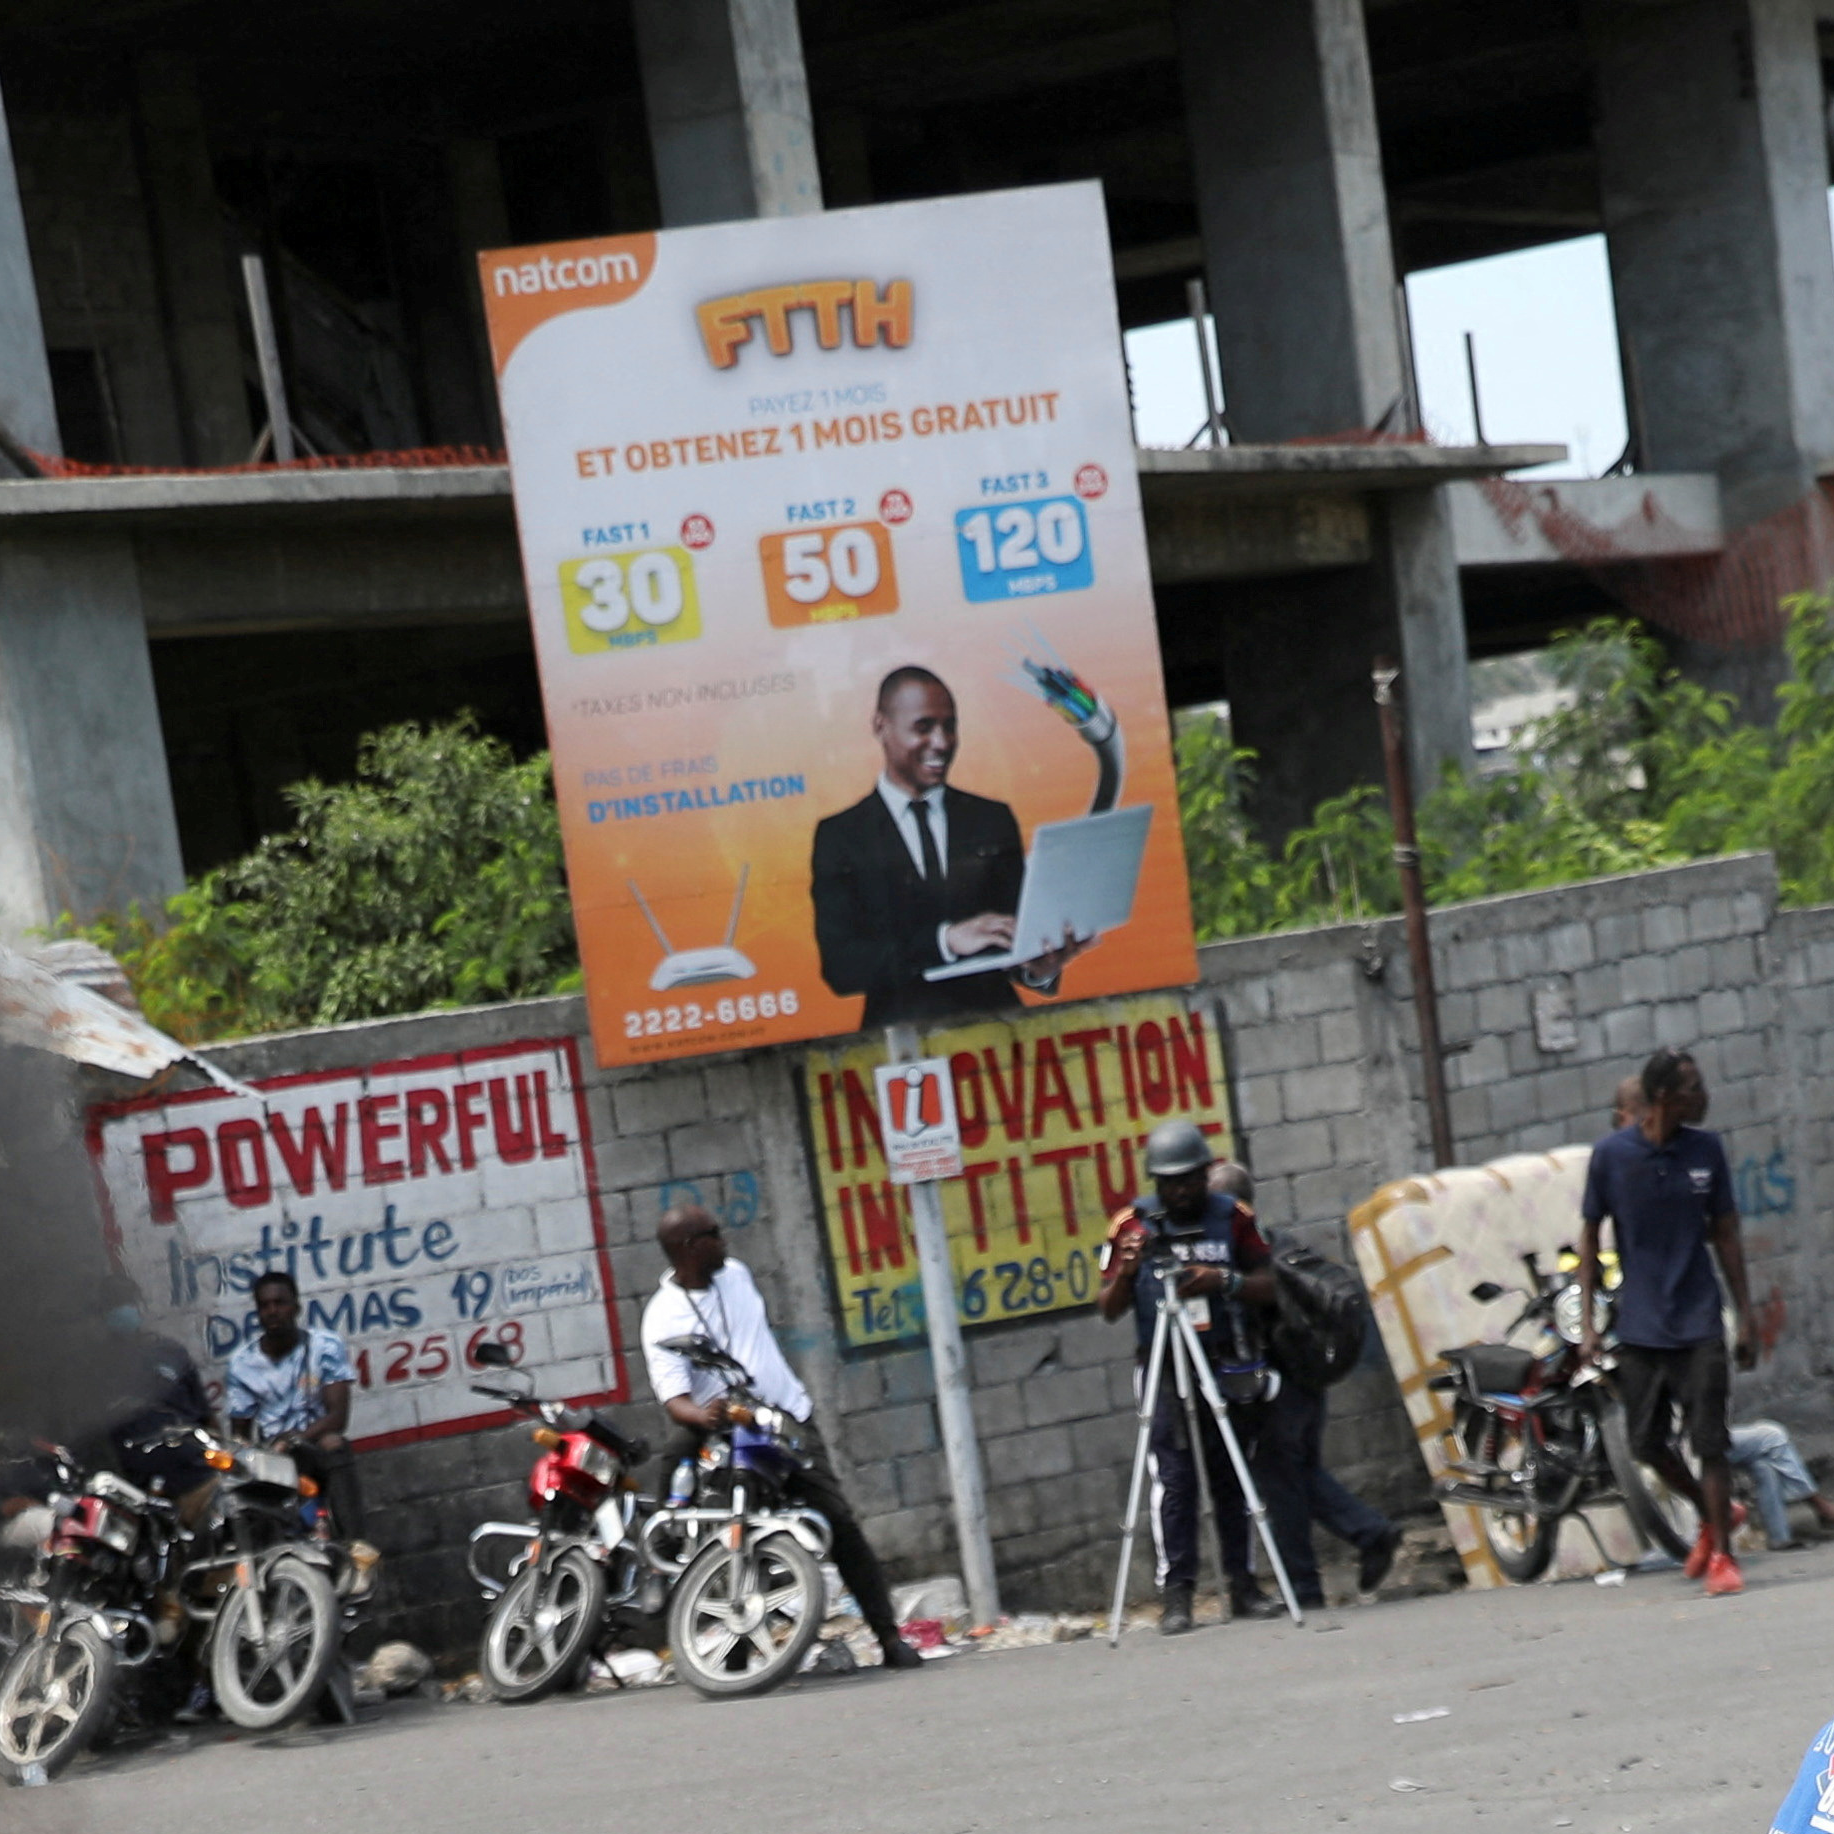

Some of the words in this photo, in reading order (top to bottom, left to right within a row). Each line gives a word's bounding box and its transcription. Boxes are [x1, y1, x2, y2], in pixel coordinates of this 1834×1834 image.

[494, 251, 639, 297] natcom
[696, 279, 914, 370] FTTH
[750, 391, 814, 416] PAYEZ
[820, 389, 830, 410] 1
[832, 382, 887, 407] MOIS
[576, 446, 615, 478] ET
[625, 426, 783, 472] OBTENEZ
[789, 423, 805, 451] 1
[813, 410, 904, 450] MOIS
[911, 391, 1059, 437] GRATUIT
[978, 473, 1030, 496] FAST
[1037, 470, 1050, 489] 3
[582, 524, 634, 547] FAST
[641, 521, 651, 540] 1
[786, 500, 838, 523] FAST
[844, 498, 856, 517] 2
[961, 500, 1085, 573] 120
[575, 550, 684, 633] 30
[783, 527, 881, 605] 50
[647, 688, 692, 710] NON
[584, 768, 622, 789] PAS
[628, 764, 653, 785] DE
[660, 755, 719, 779] FRAIS
[588, 773, 806, 824] D'INSTALLATION
[623, 988, 800, 1039] 2222-6666
[818, 1012, 1215, 1173] INOVATION
[140, 1068, 570, 1225] POWERFUL
[168, 1204, 460, 1306] Institute
[206, 1287, 423, 1357] DEMAS
[451, 1269, 495, 1320] 19
[385, 1335, 450, 1383] 25
